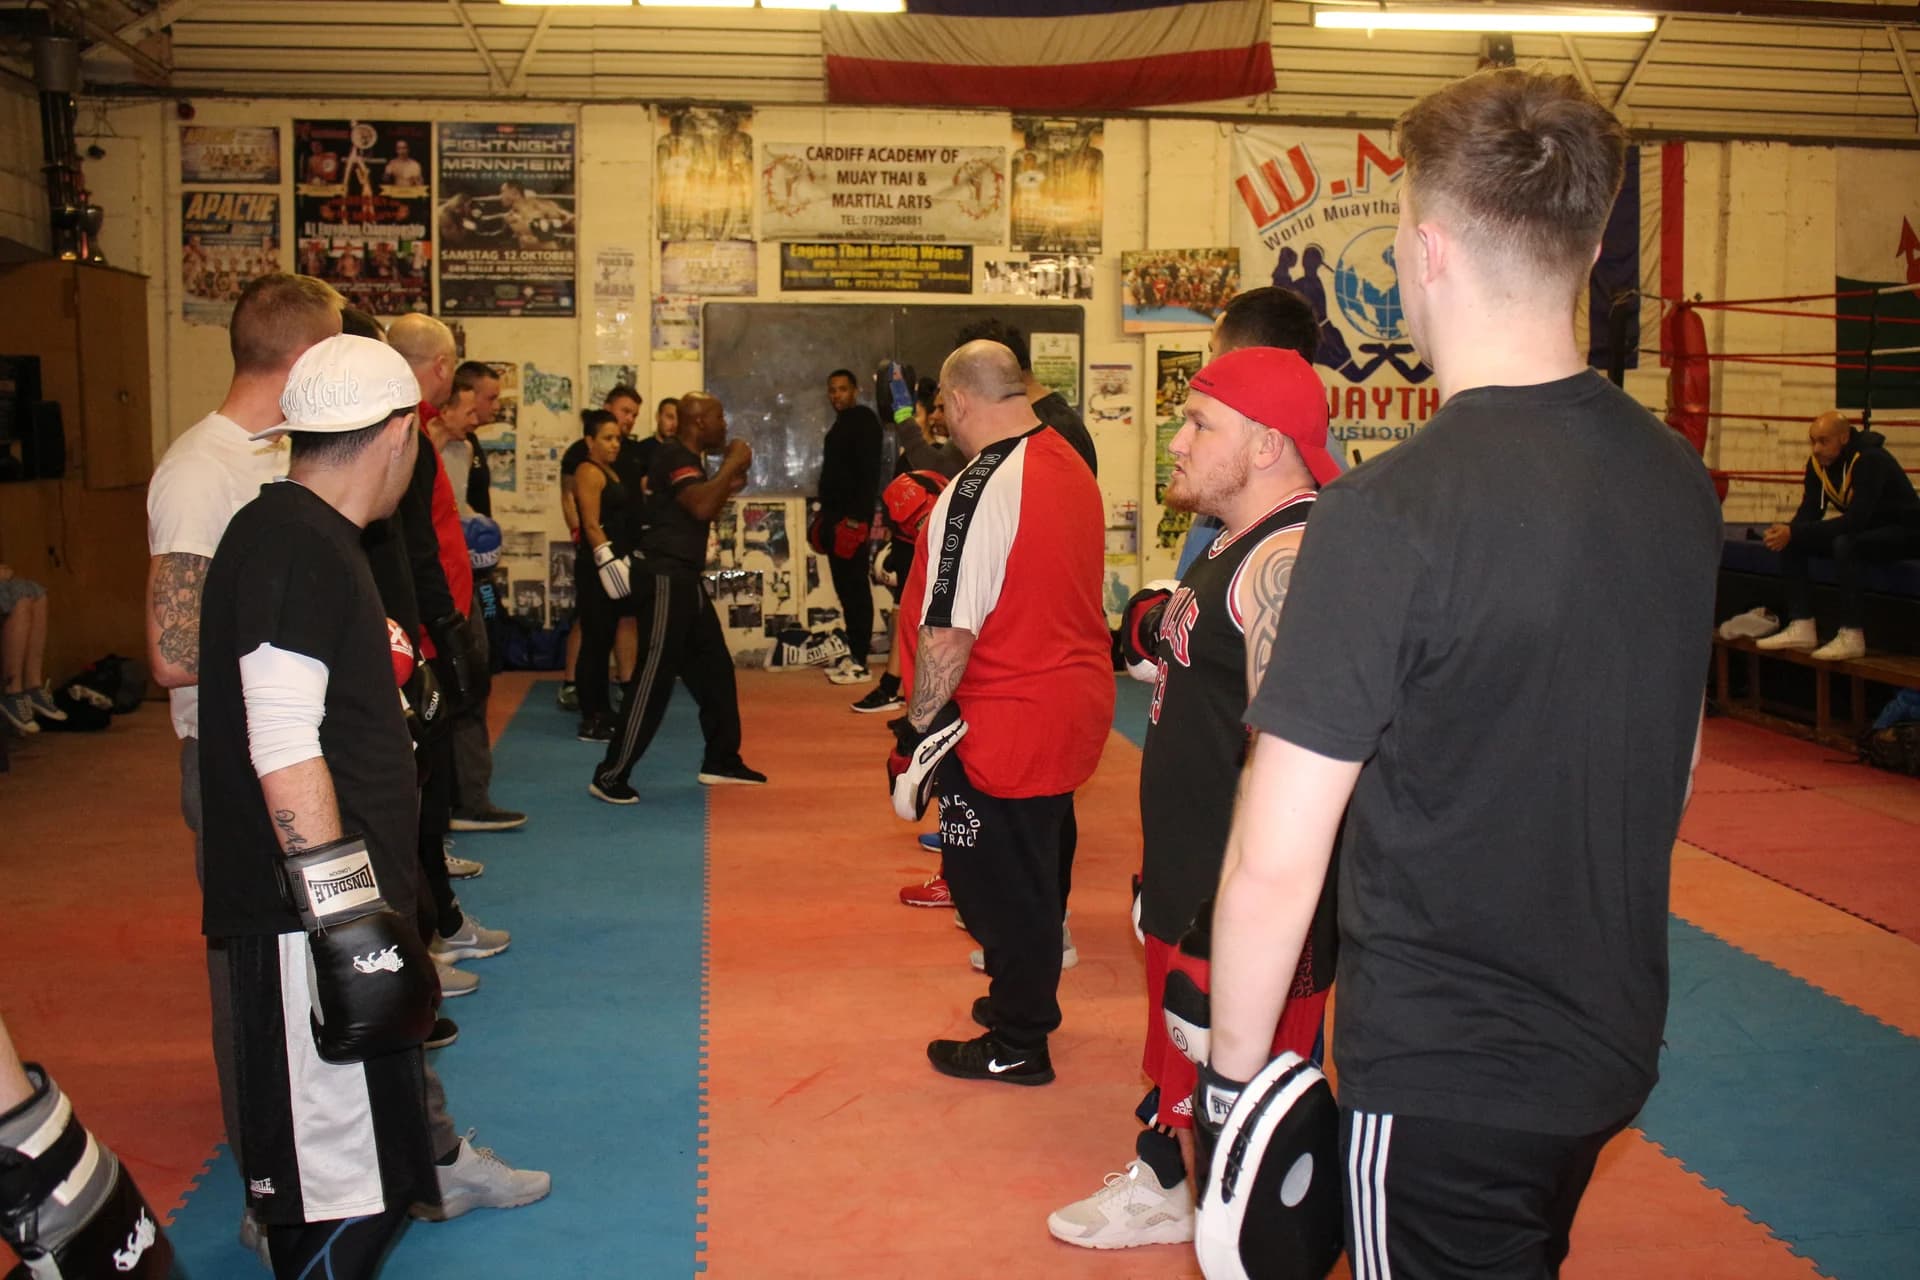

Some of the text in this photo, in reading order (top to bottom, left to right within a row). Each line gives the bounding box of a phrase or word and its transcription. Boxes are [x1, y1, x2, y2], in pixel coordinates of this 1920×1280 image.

[806, 147, 960, 164] CARDIFF ACADEMY OF
[442, 158, 570, 171] MANNHEIM
[837, 170, 927, 187] MUAY THAI &
[186, 193, 277, 222] APACHE
[832, 194, 932, 210] MARTIAL ARTS
[1263, 200, 1400, 251] World Muaytha
[441, 250, 499, 261] SAMSTAG
[934, 453, 1001, 595] NEW YORK
[312, 863, 376, 904] LONSDALE
